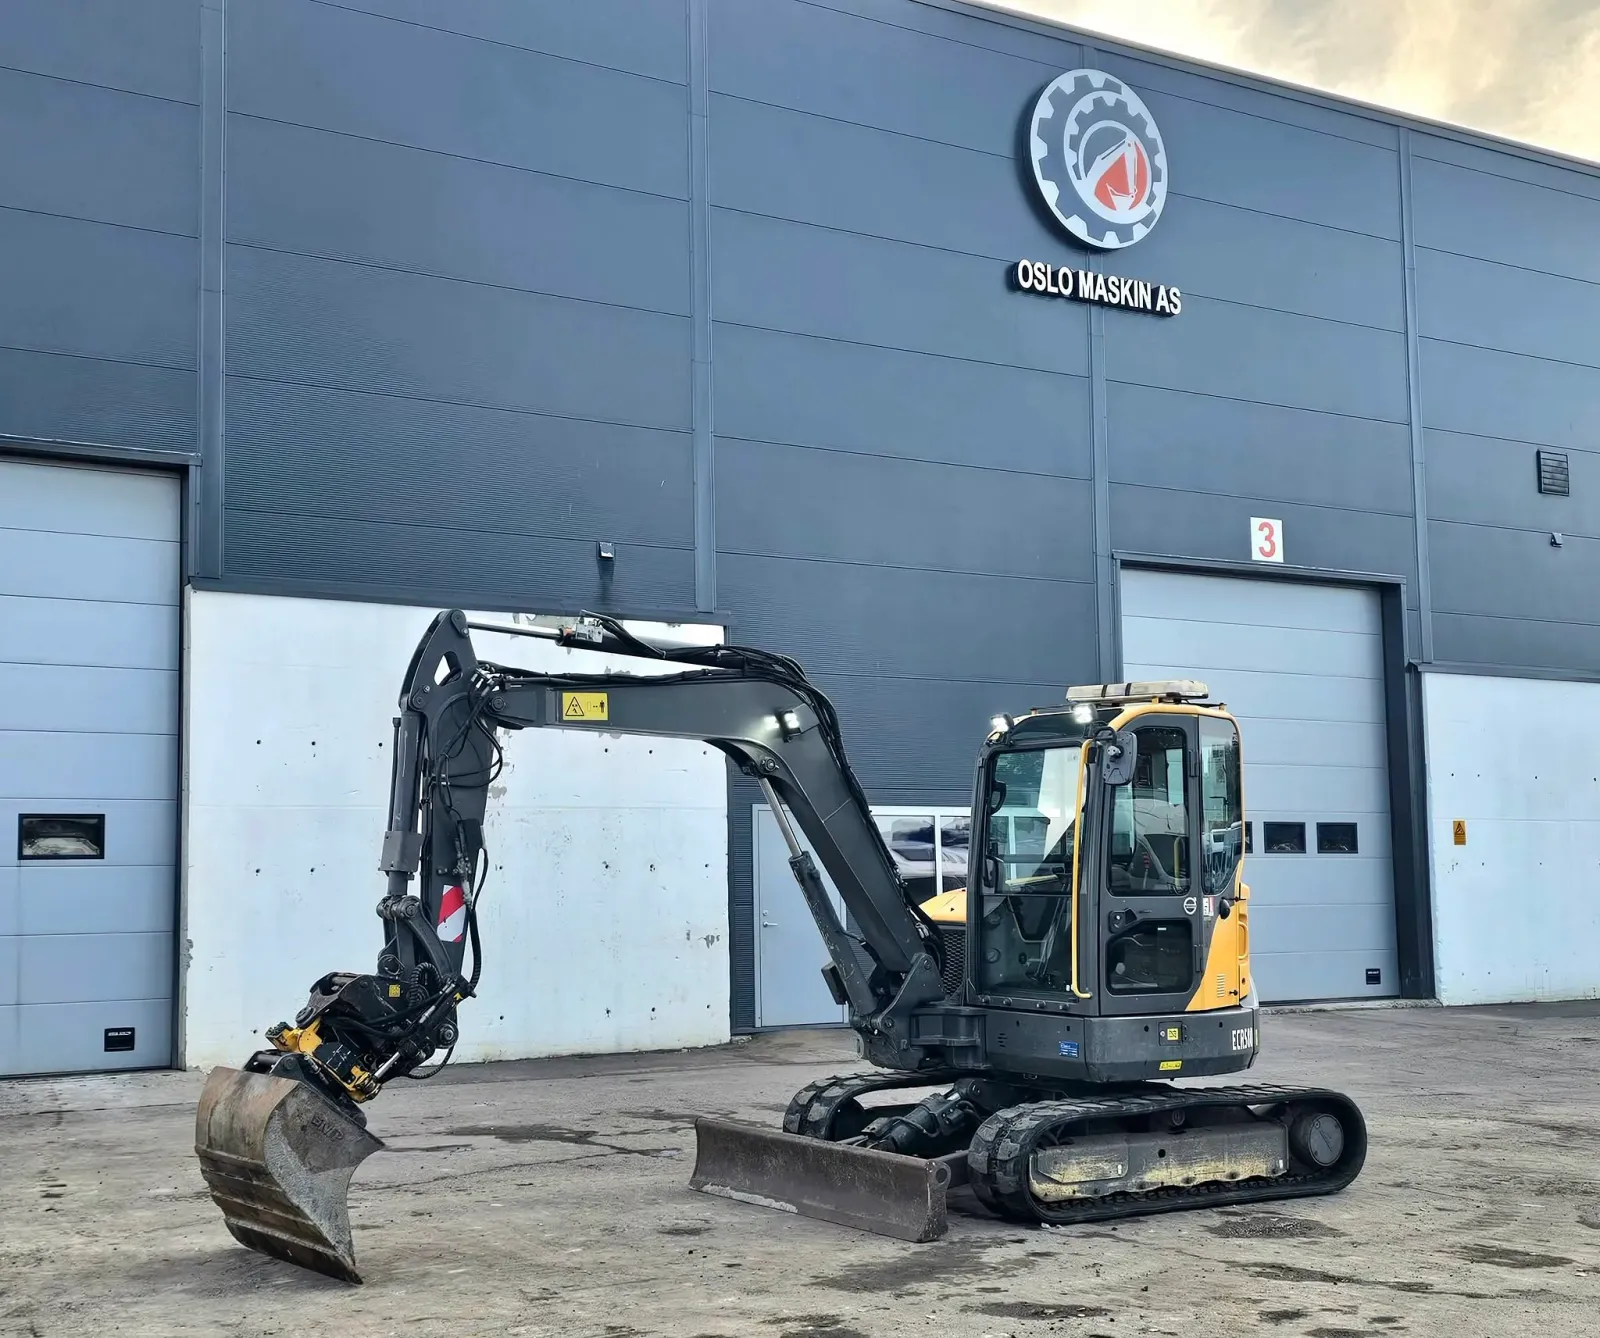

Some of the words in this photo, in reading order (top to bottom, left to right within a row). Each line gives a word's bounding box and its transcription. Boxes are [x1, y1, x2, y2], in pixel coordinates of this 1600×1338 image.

[1017, 258, 1074, 296] OSLO
[1078, 269, 1152, 310] MASKIN
[1156, 284, 1182, 315] AS
[1258, 521, 1276, 558] 3
